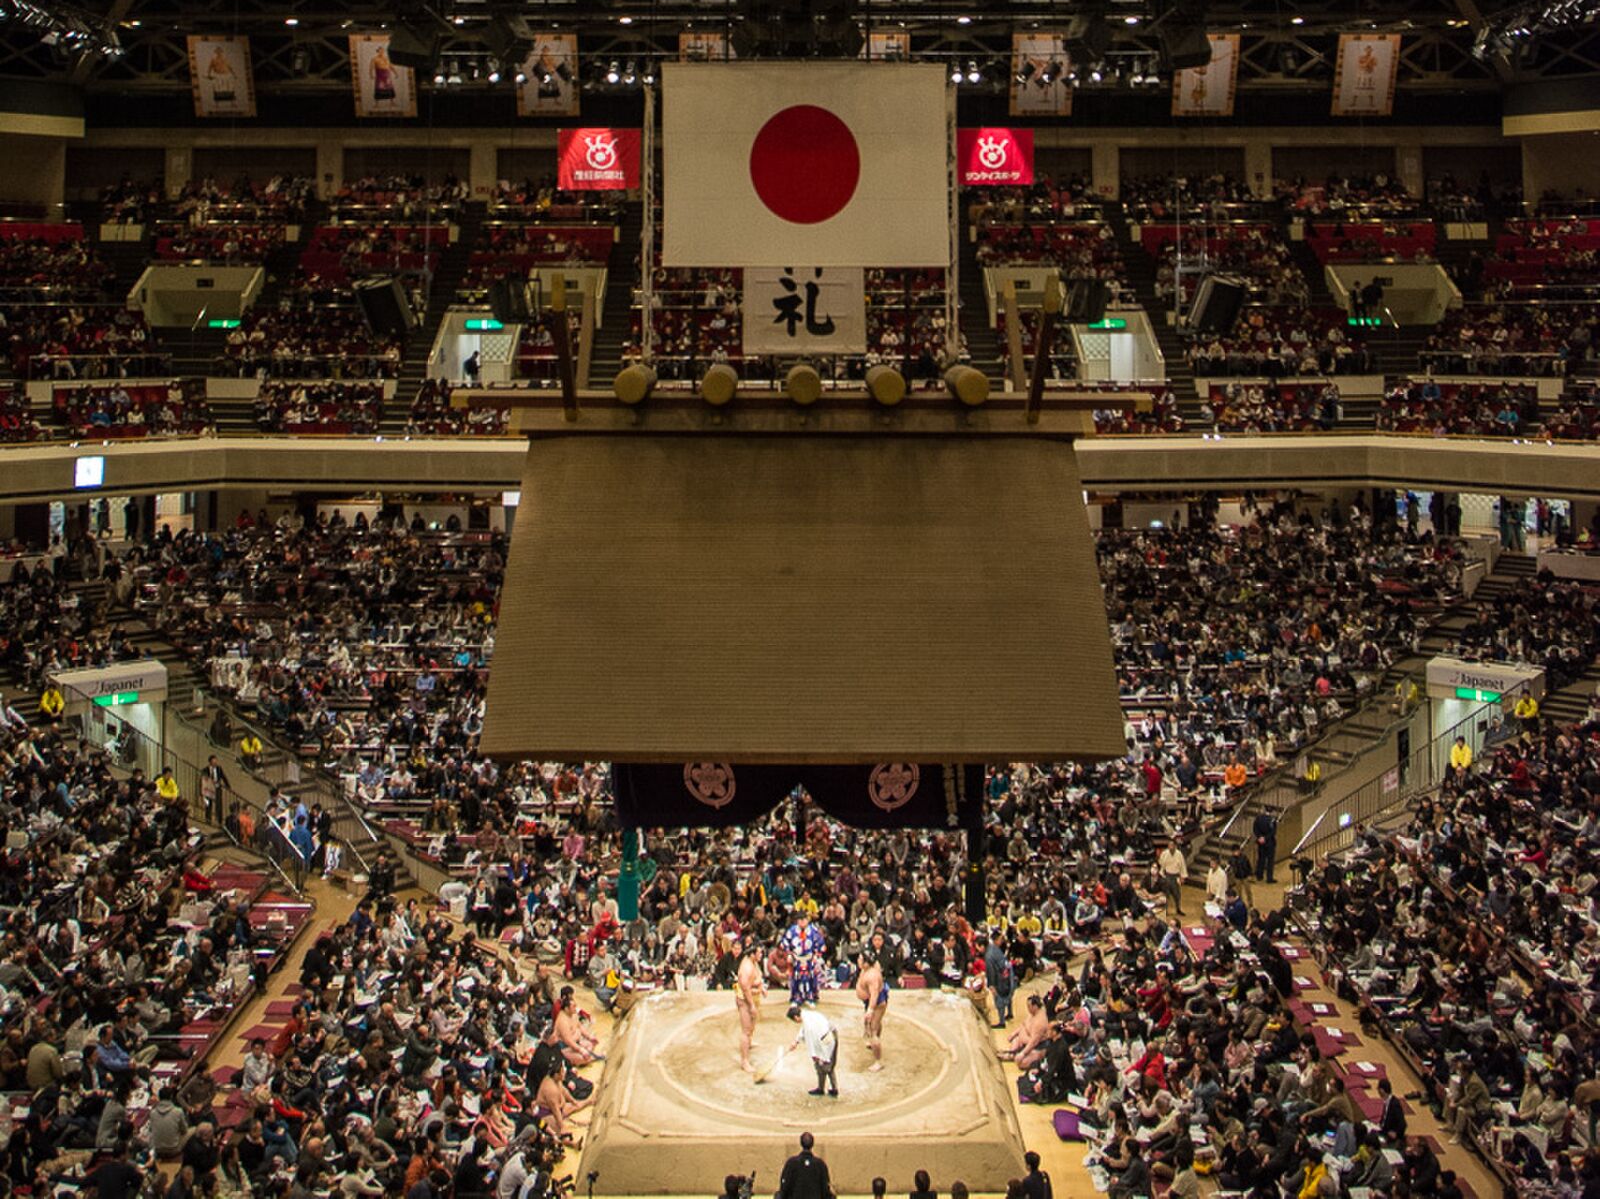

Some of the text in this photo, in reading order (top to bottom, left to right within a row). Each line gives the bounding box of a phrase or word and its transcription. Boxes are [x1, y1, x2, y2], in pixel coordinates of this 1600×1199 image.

[773, 267, 835, 338] 礼
[101, 678, 144, 693] Japanet
[1460, 673, 1504, 690] Japanet
